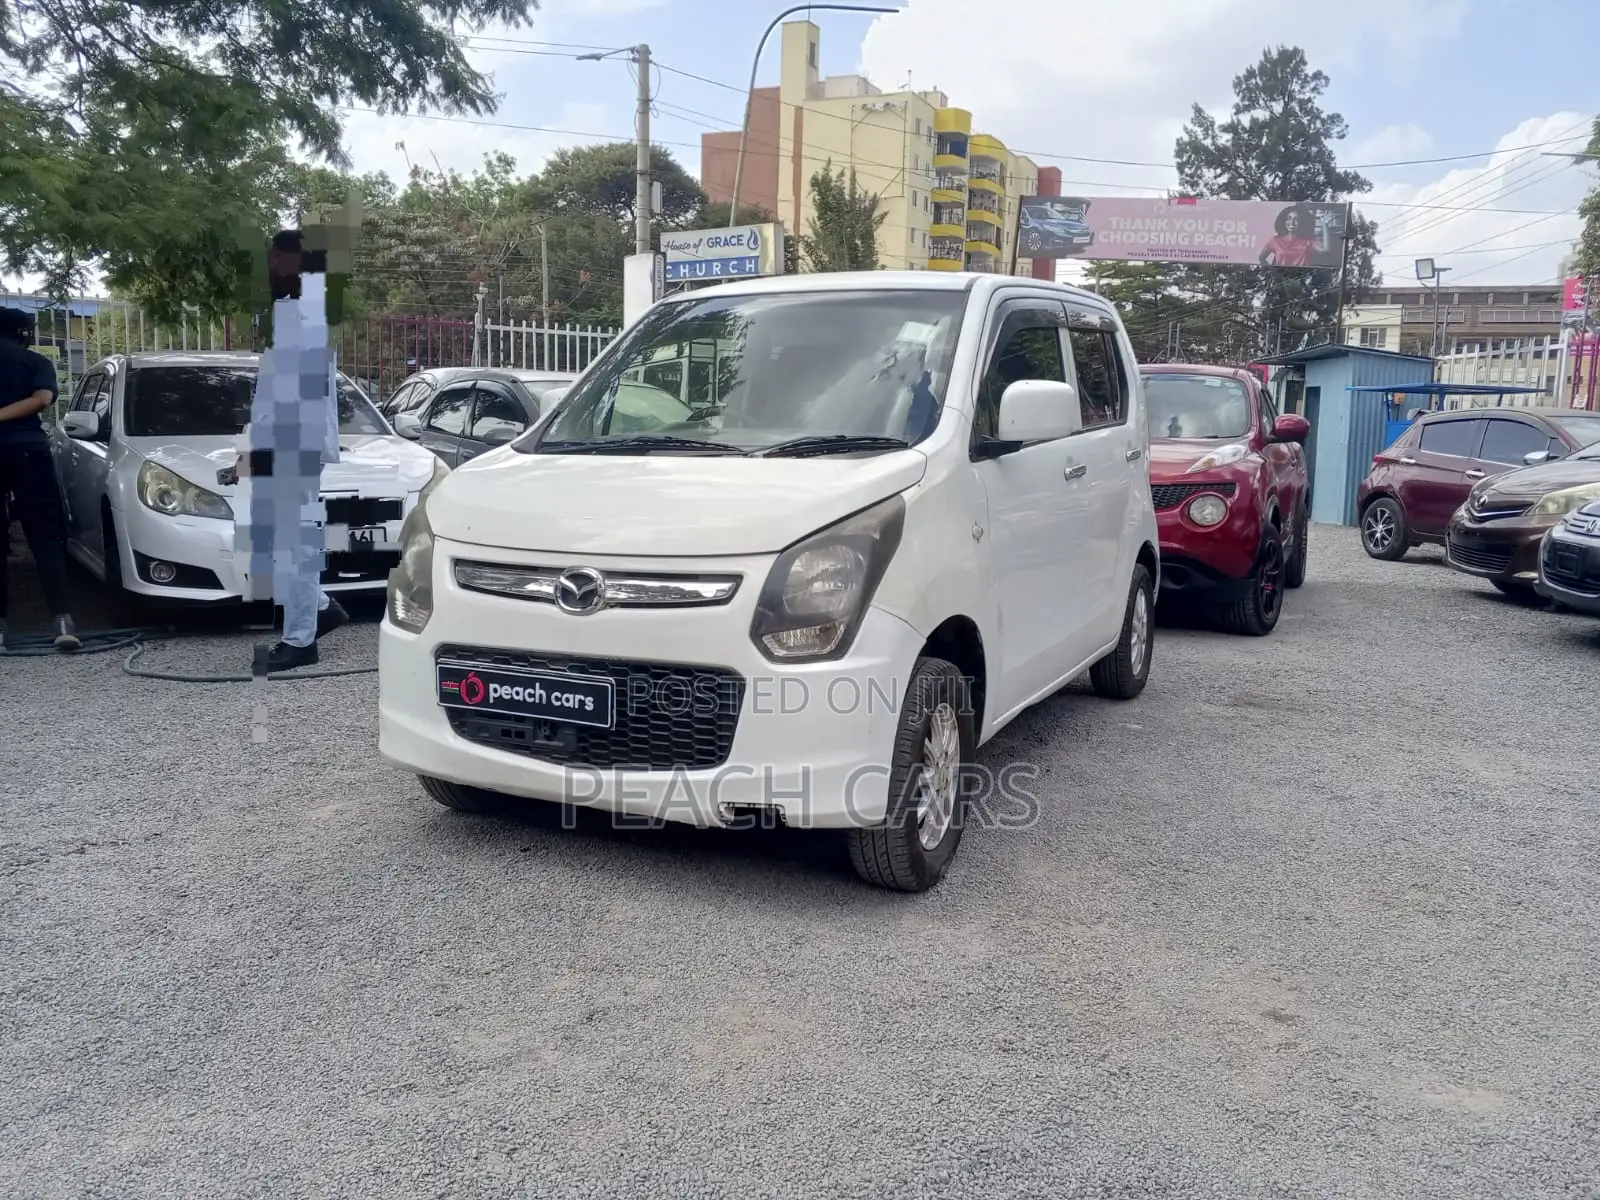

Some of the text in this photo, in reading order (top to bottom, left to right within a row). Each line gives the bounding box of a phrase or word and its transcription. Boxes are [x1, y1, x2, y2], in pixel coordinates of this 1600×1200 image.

[1109, 217, 1247, 233] THANK YOU FOR
[692, 238, 703, 254] of
[707, 234, 744, 249] GRACE
[1098, 231, 1257, 248] CHOOSING PEACH!
[666, 259, 755, 277] CHURCH
[488, 681, 594, 711] peach cars
